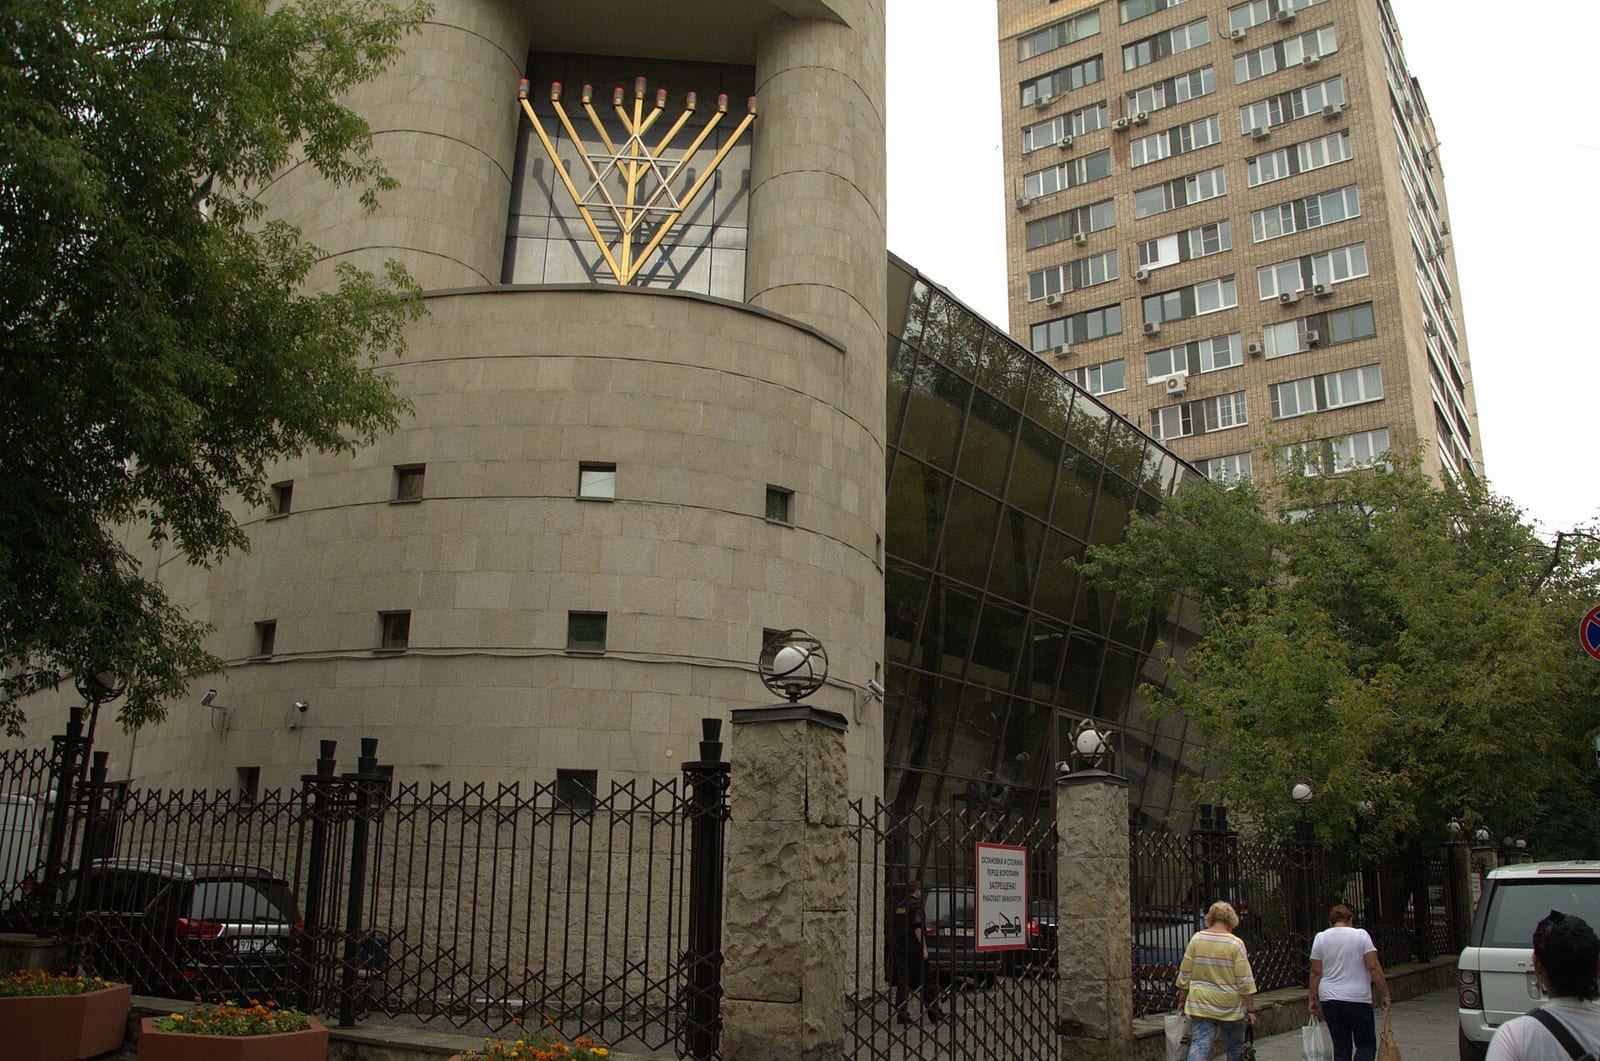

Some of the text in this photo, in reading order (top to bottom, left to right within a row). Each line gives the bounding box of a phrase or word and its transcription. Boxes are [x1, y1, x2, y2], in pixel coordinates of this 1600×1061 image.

[981, 856, 1003, 865] ОСТАНОВКА
[1007, 858, 1023, 866] СТОЯНКА
[986, 868, 1019, 877] ПЕРЕД ВОРОТАМИ
[982, 894, 1001, 902] РАБОТАЕТ
